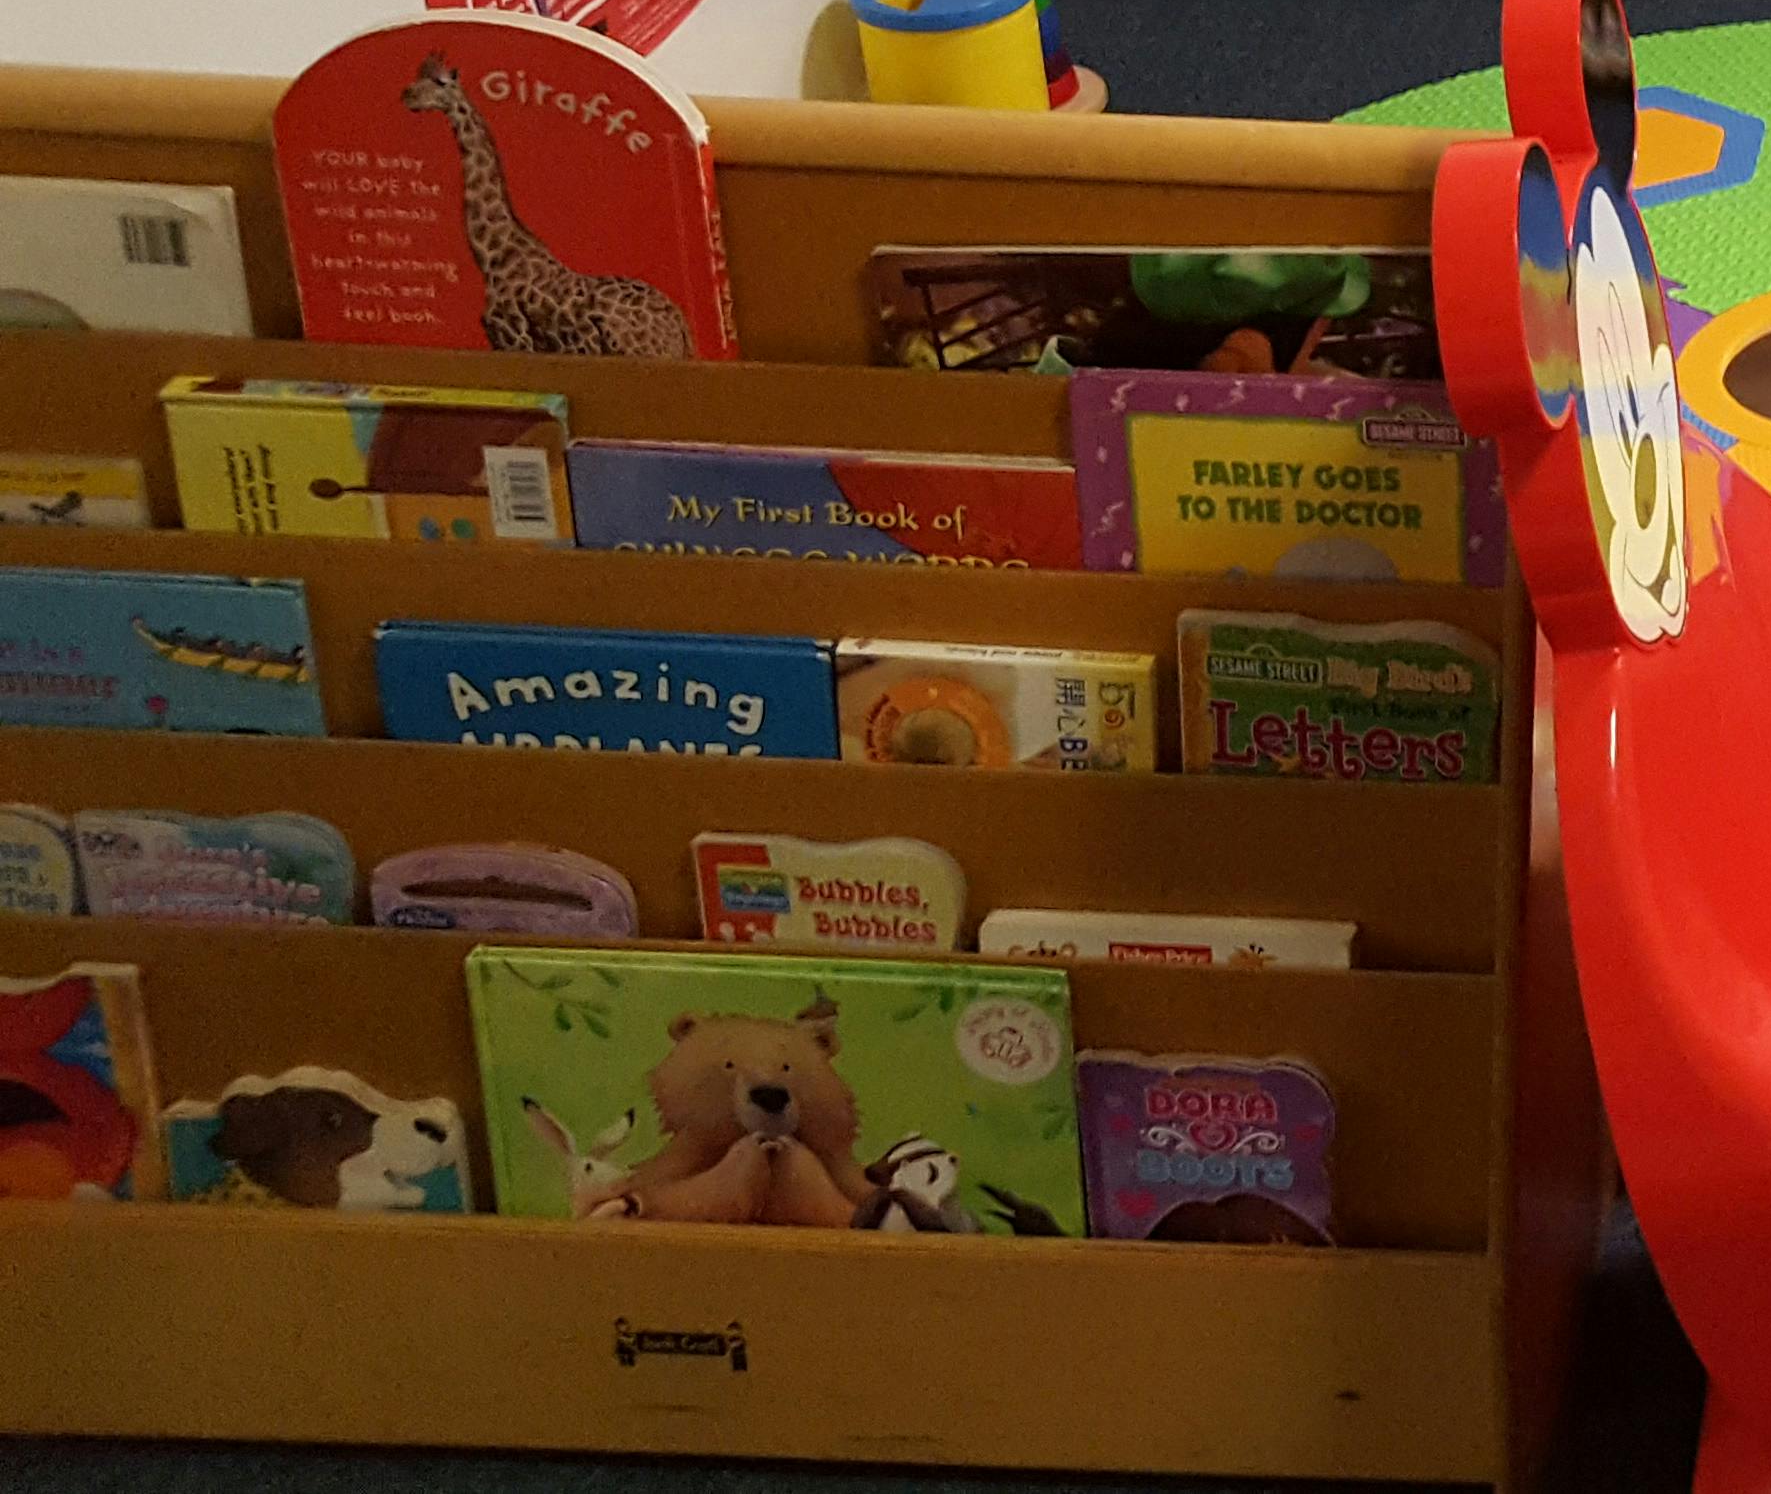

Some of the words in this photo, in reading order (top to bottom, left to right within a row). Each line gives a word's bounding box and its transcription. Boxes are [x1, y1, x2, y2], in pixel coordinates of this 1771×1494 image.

[480, 69, 653, 154] Giraffe
[312, 151, 369, 168] YOUR
[376, 156, 425, 174] baby
[301, 178, 340, 193] will
[347, 178, 400, 196] LOVE
[410, 179, 442, 197] the
[315, 203, 357, 219] wild
[363, 204, 438, 222] animals
[349, 230, 367, 245] in
[374, 230, 412, 246] this
[341, 281, 395, 298] touch
[400, 283, 437, 299] and
[343, 307, 387, 323] feel
[1368, 420, 1416, 440] SESAME
[1417, 423, 1463, 443] STREET
[1193, 459, 1304, 490] FARLEY
[1313, 464, 1402, 492] GOES
[665, 493, 723, 528] My
[732, 496, 814, 525] First
[823, 502, 920, 532] Book
[932, 505, 968, 542] of
[1177, 494, 1217, 522] TO
[1226, 496, 1282, 524] THE
[1295, 498, 1423, 530] DOCTOR
[1210, 657, 1263, 677] SESAME
[1265, 661, 1319, 683] STREET
[446, 661, 766, 736] Amazing
[1208, 698, 1466, 780] Letters
[794, 874, 930, 915] Bubbles,
[812, 910, 938, 944] Bubbles
[1143, 1087, 1279, 1125] DORA
[1137, 1147, 1296, 1191] BOOTS
